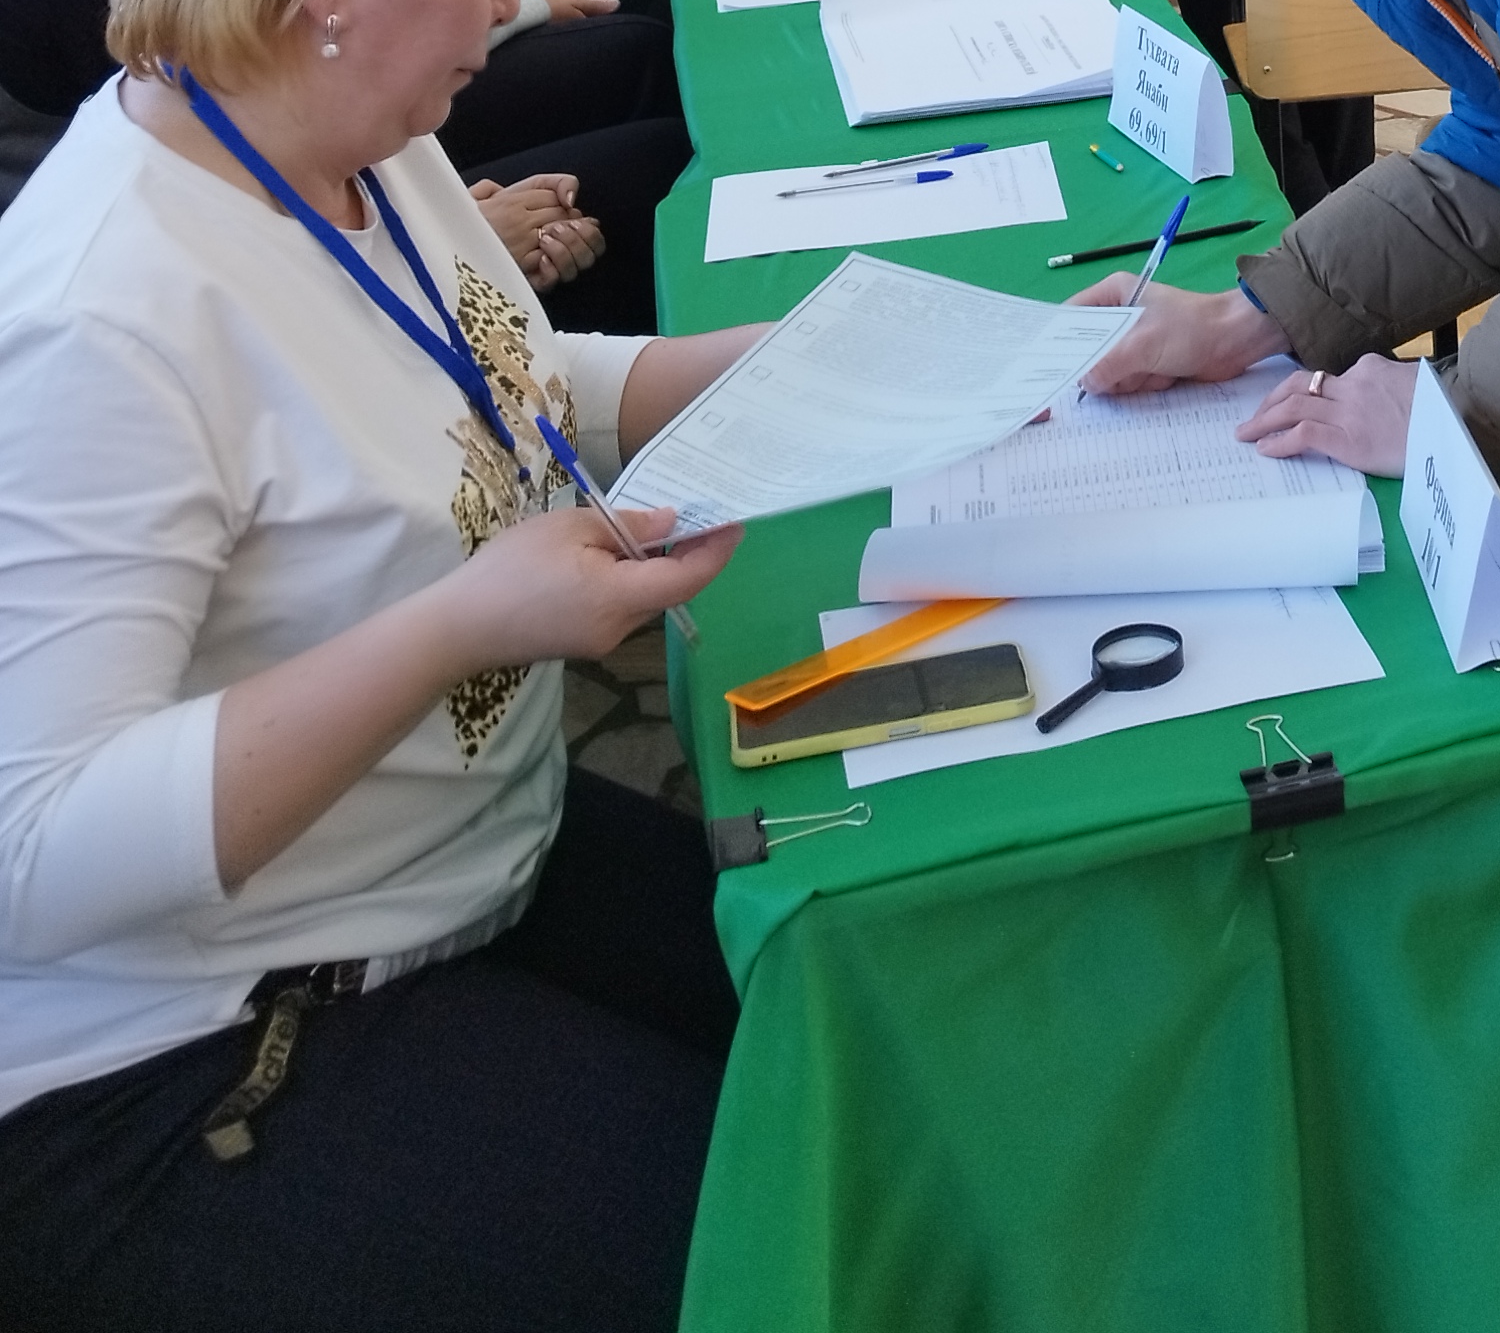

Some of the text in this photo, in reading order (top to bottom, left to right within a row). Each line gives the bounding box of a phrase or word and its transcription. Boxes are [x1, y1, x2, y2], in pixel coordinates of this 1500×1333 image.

[1137, 26, 1180, 76] Тухвата
[1136, 69, 1170, 113] Янаби
[1145, 120, 1167, 154] 69/1
[1425, 454, 1456, 550] Ферина
